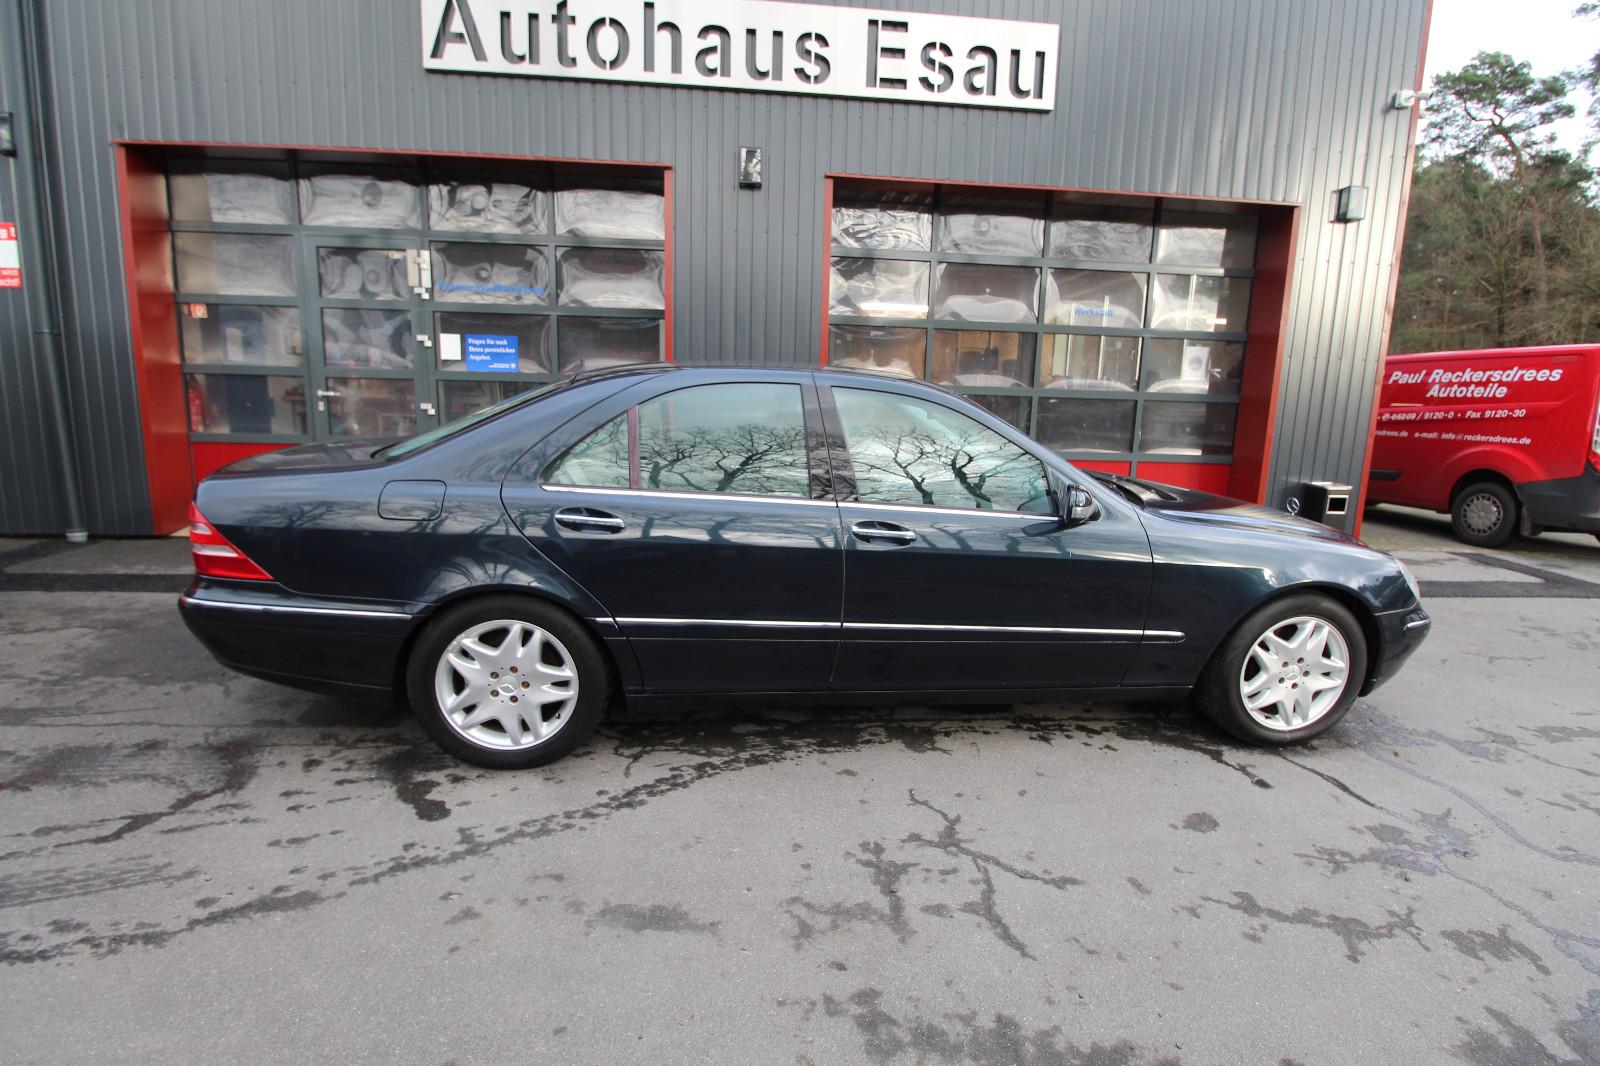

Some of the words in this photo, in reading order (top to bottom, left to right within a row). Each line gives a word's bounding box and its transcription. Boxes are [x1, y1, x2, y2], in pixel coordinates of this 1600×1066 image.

[430, 0, 831, 85] Autohaus
[866, 18, 1046, 100] Esau
[1388, 370, 1427, 384] Paul
[1428, 366, 1564, 383] Reckersdrees
[1426, 383, 1508, 398] Autoteile
[1465, 410, 1482, 418] Fax
[1484, 408, 1527, 418] 9120-30
